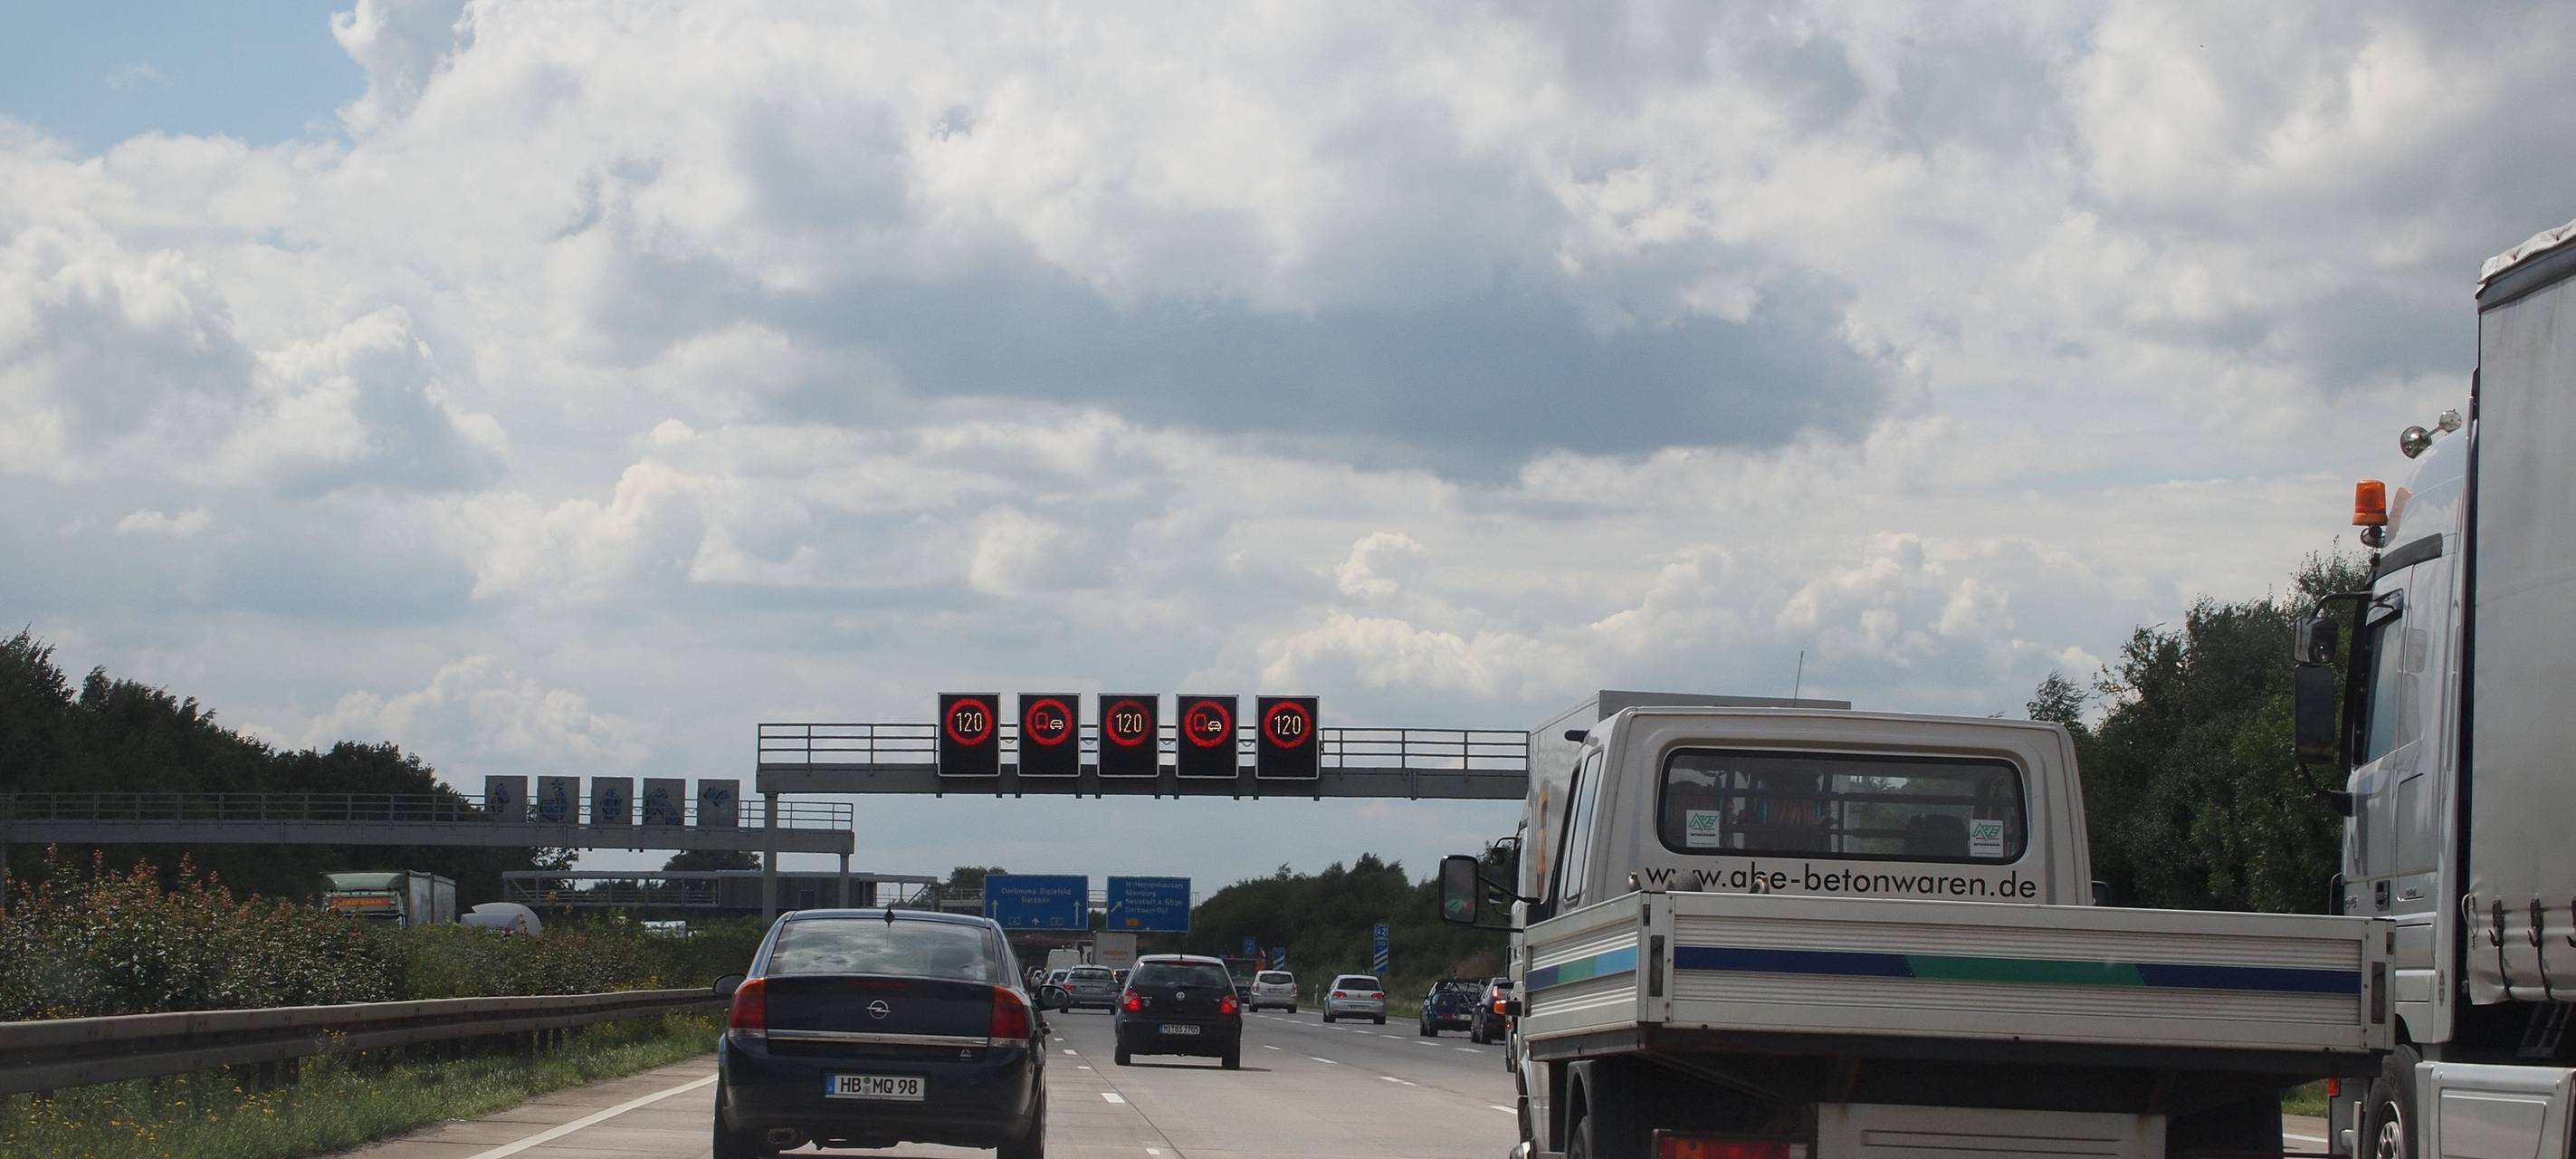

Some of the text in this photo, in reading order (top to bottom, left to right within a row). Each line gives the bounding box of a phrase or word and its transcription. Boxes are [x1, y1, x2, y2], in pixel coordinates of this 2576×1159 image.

[956, 712, 983, 733] 120
[1116, 713, 1142, 733] 120
[1274, 714, 1302, 735] 120
[1645, 861, 2037, 898] ww.abe-betonwaren.de
[1000, 886, 1036, 896] Dortmund
[840, 1077, 918, 1095] HB MQ 98
